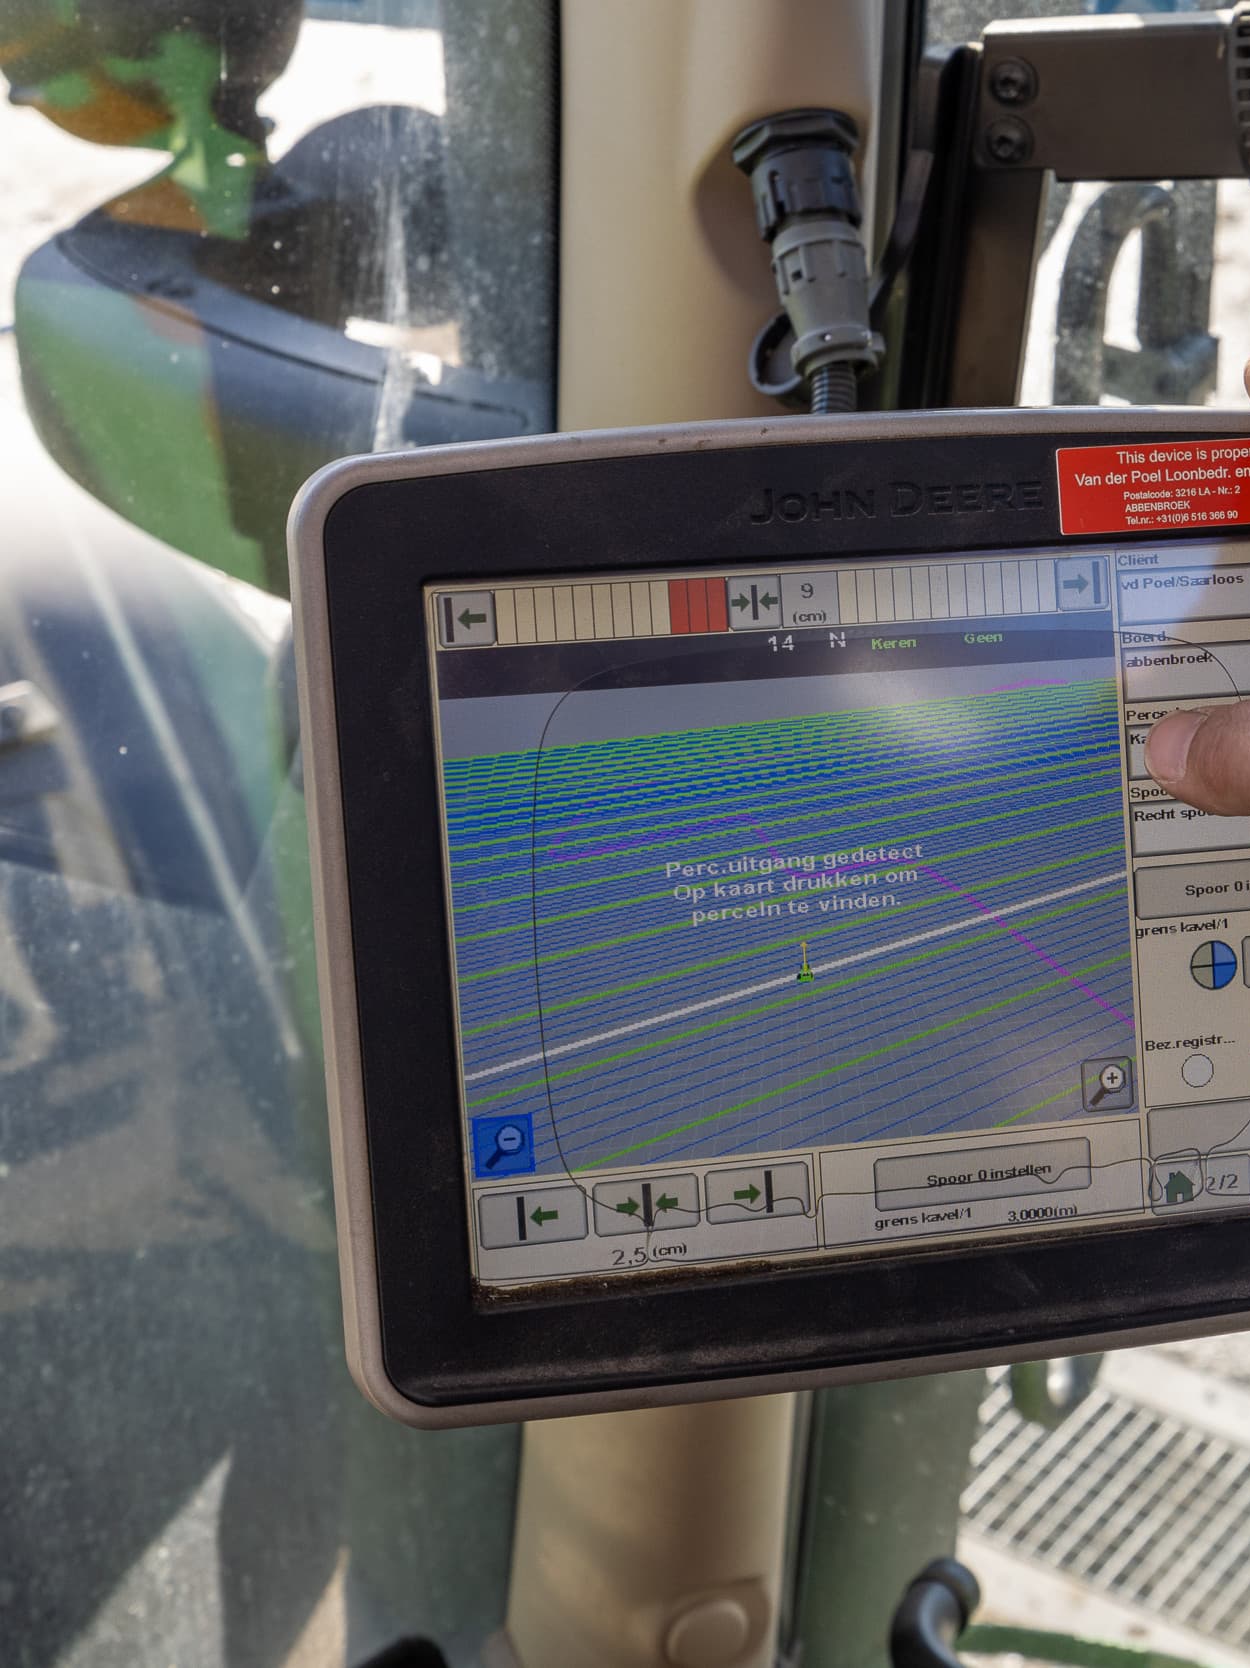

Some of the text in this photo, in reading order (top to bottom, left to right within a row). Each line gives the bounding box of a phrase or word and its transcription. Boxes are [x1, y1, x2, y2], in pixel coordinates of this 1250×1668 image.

[1117, 451, 1145, 465] This
[1149, 449, 1193, 463] device
[1196, 447, 1208, 460] is
[1075, 473, 1101, 487] Van
[1105, 471, 1127, 485] der
[1131, 469, 1162, 483] Poel
[1165, 466, 1231, 482] Loonbedr.
[1123, 489, 1174, 501] Postalcode:
[1175, 487, 1197, 498] 3216
[1198, 487, 1212, 496] LA
[1218, 486, 1233, 495] Nr.:
[1234, 485, 1241, 494] 2
[751, 481, 1045, 525] JOHN DEERE
[1125, 500, 1191, 513] ABBENBROEK
[1125, 510, 1239, 525] Tel.nr.: +31(0)6 516 366 90
[801, 583, 814, 599] 9
[1121, 574, 1244, 590] vd Poel/Saarloos
[792, 611, 827, 624] (cm)
[767, 632, 846, 651] 14 N
[871, 637, 917, 650] Keren
[964, 632, 1003, 644] Geen
[1126, 651, 1213, 668] abbenbroek
[1134, 808, 1176, 822] Recht
[665, 843, 924, 878] Perc.uitgang gedetect
[673, 868, 918, 903] Op kaart drukken om
[1185, 883, 1230, 898] Spoor
[1234, 880, 1243, 892] 0
[788, 899, 810, 914] te
[819, 891, 902, 912] vinden.
[1136, 918, 1229, 939] grens kavel/1
[1145, 1034, 1236, 1051] Bez.registr...
[927, 1163, 1051, 1188] Spoor 0 instellen
[1207, 1173, 1239, 1191] 2/2
[875, 1207, 972, 1230] grens kavel/1
[611, 1243, 687, 1266] 2,5 (cm)
